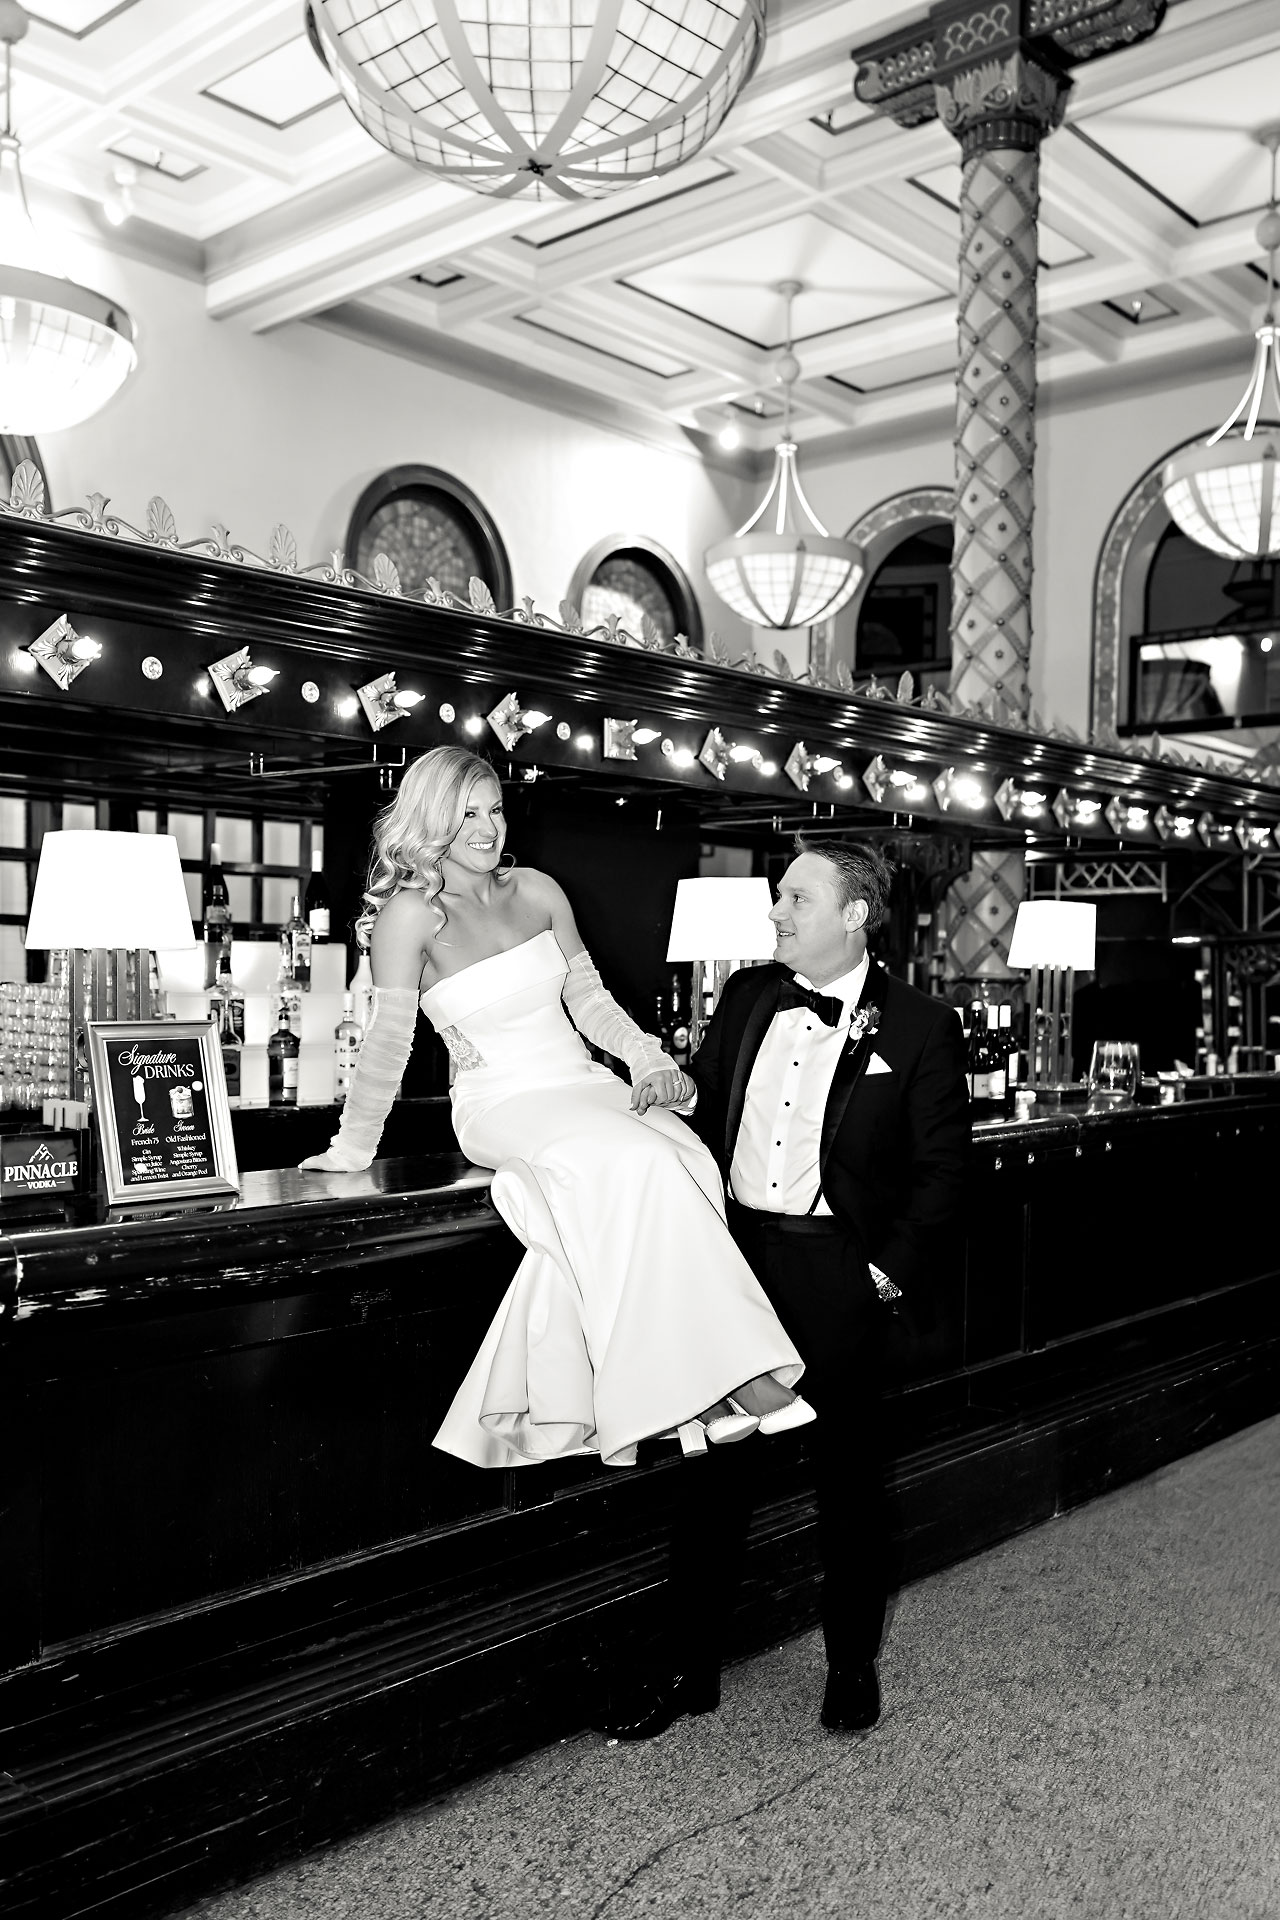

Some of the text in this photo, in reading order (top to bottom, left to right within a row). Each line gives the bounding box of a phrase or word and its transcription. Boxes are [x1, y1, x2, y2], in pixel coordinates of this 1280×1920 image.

[118, 1044, 177, 1075] Signature
[145, 1064, 194, 1079] DRINKS
[132, 1123, 154, 1136] Bride
[177, 1133, 206, 1142] Fashioned
[4, 1161, 78, 1182] PINNACLE
[27, 1180, 57, 1189] VODKA
